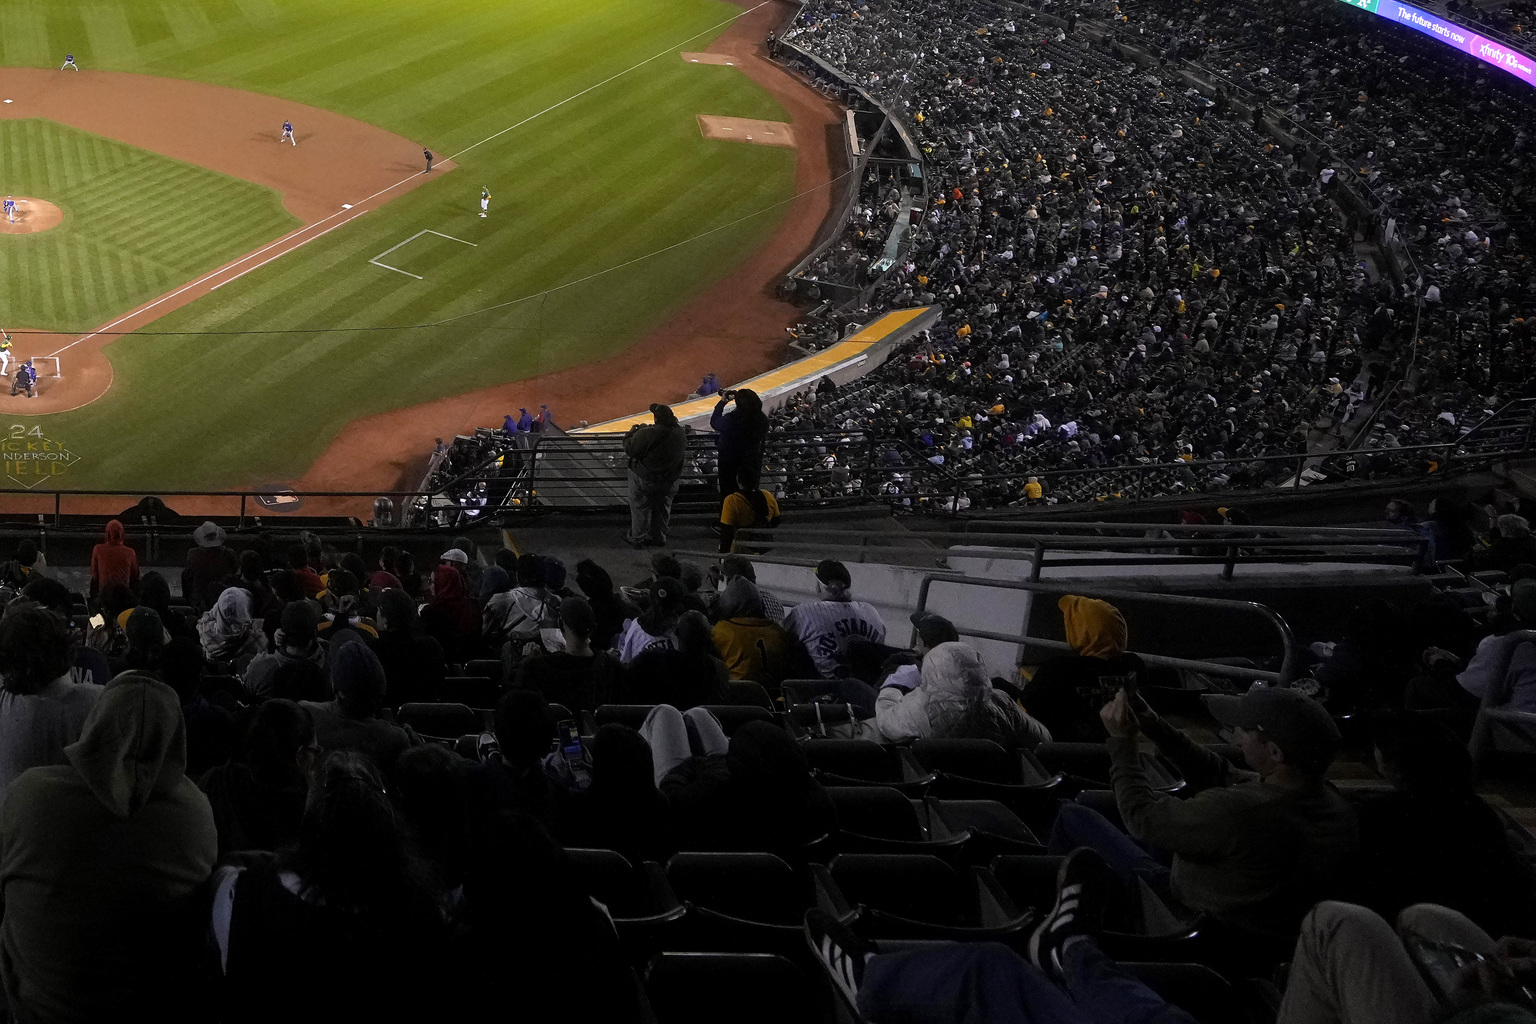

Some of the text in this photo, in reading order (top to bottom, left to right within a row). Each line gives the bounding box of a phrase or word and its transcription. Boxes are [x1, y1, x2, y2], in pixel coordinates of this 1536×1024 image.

[1398, 6, 1466, 44] The future starts now
[1479, 43, 1505, 64] xfinity
[10, 424, 44, 439] 24
[755, 639, 768, 673] 1
